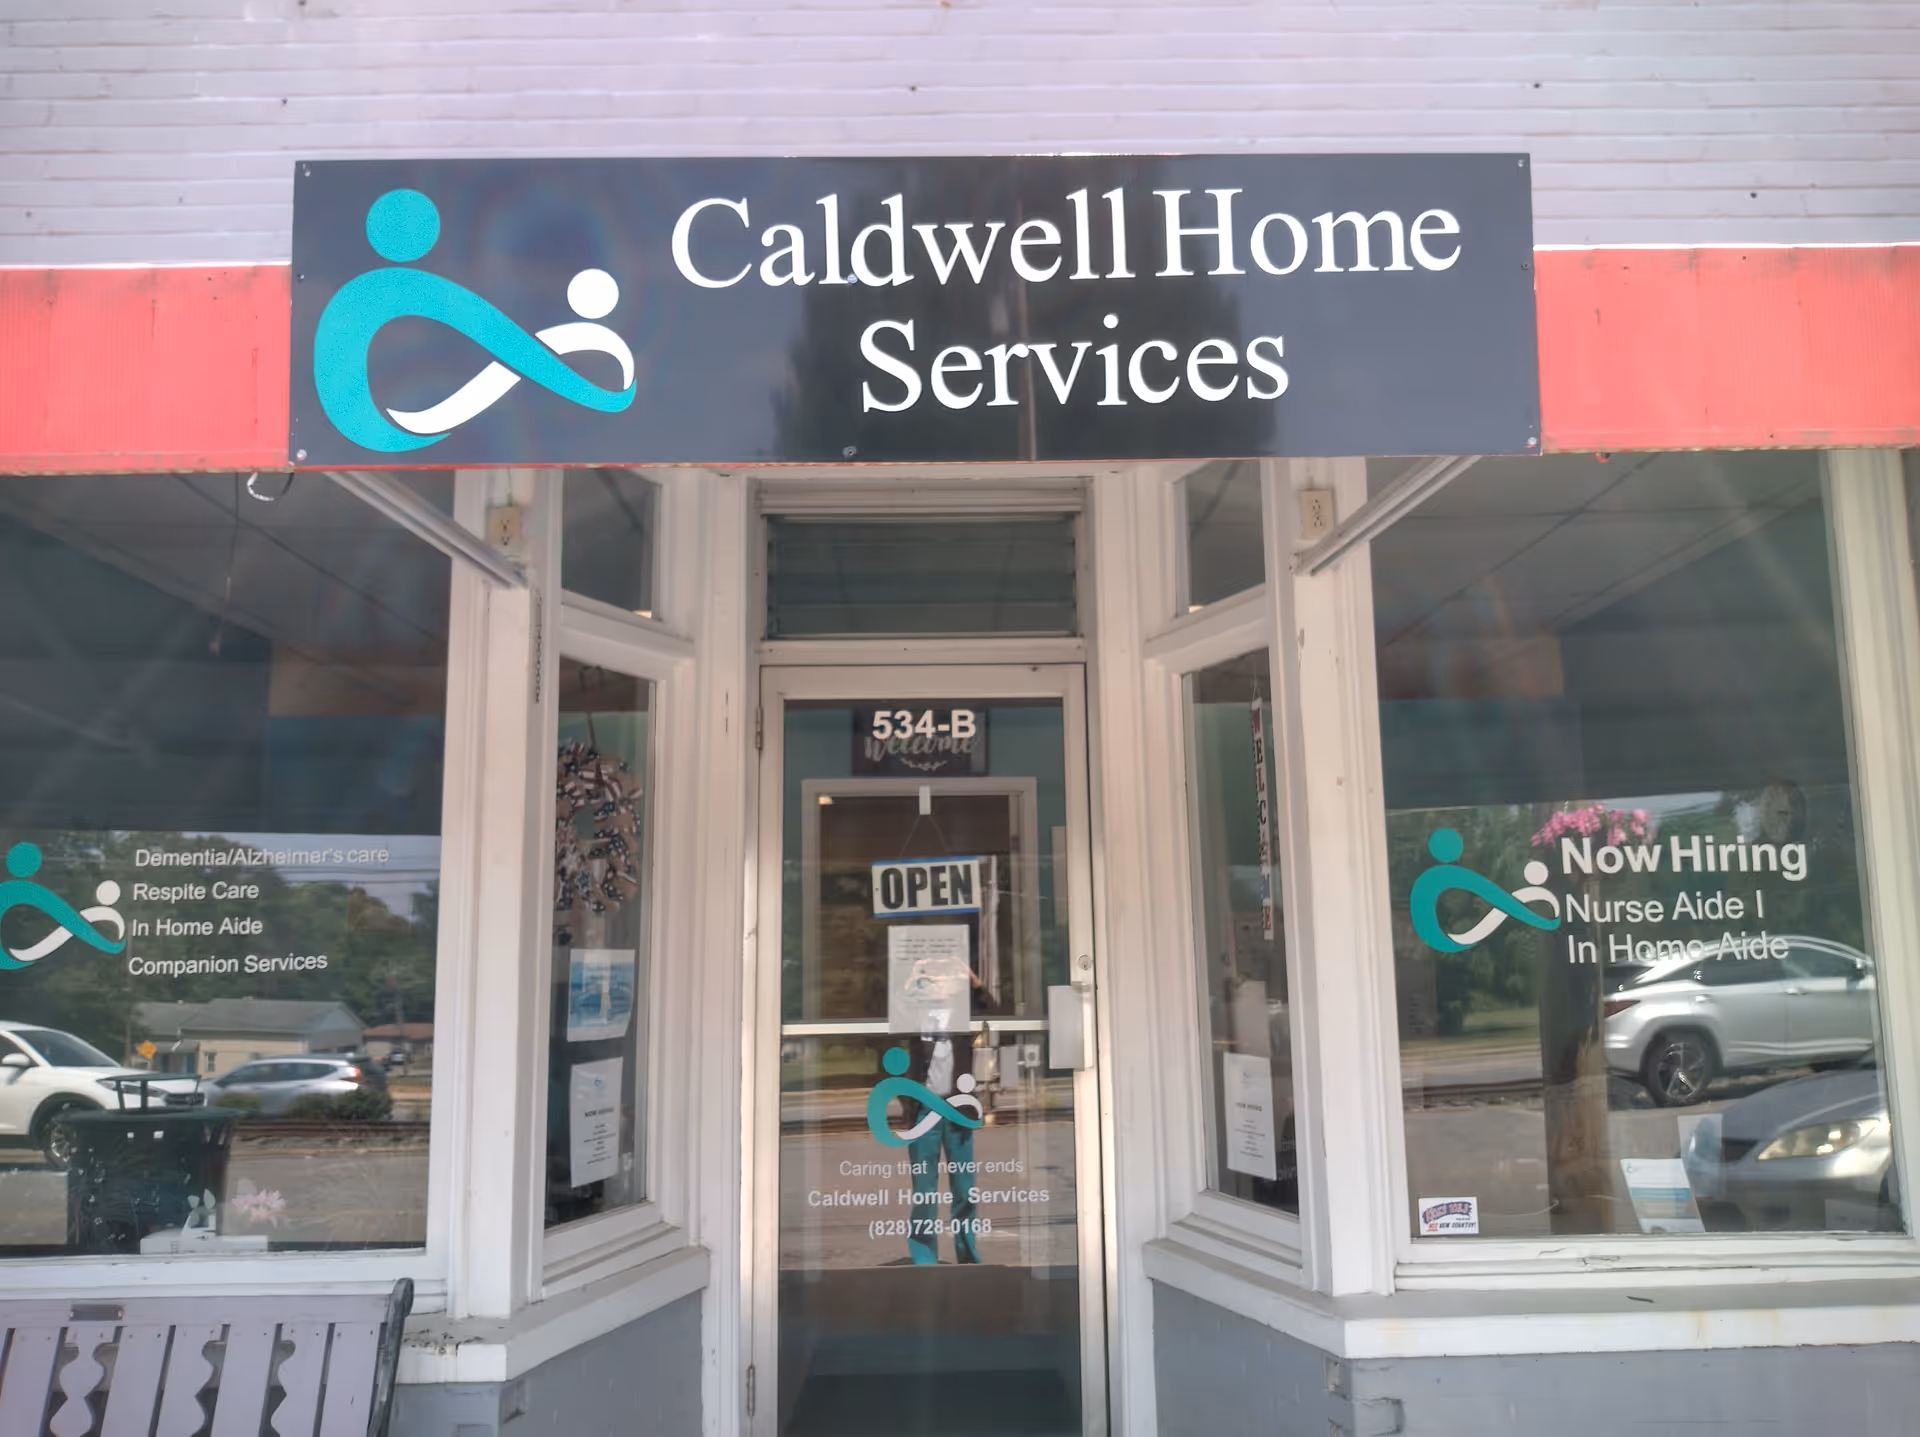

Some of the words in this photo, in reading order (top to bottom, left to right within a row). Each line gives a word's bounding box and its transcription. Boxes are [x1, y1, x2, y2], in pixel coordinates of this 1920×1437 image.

[669, 187, 1136, 290] Caldwell
[1153, 187, 1463, 276] Home
[858, 313, 1290, 414] Services
[872, 709, 977, 740] 534-B
[135, 848, 344, 867] Dementia/Alzheimer's
[347, 848, 389, 863] care
[1561, 836, 1662, 874] Now
[1670, 835, 1807, 882] Hiring
[133, 882, 206, 904] Respite
[212, 881, 260, 900] Care
[880, 863, 974, 910] OPEN
[1566, 893, 1665, 923] Nurse
[1672, 890, 1744, 920] Aide
[132, 919, 149, 936] In
[155, 918, 214, 936] Home
[218, 917, 263, 935] Aide
[1568, 934, 1597, 964] In
[1608, 933, 1705, 964] Home
[1716, 930, 1789, 961] Aide
[128, 955, 239, 978] Companion
[244, 952, 328, 974] Services
[839, 1160, 892, 1179] Caring
[897, 1160, 928, 1175] that
[937, 1160, 983, 1174] never
[985, 1159, 1024, 1173] ends
[807, 1189, 889, 1207] Caldwell
[898, 1188, 953, 1205] Home
[967, 1186, 1050, 1204] Services
[868, 1218, 992, 1239] (828)728-0168
